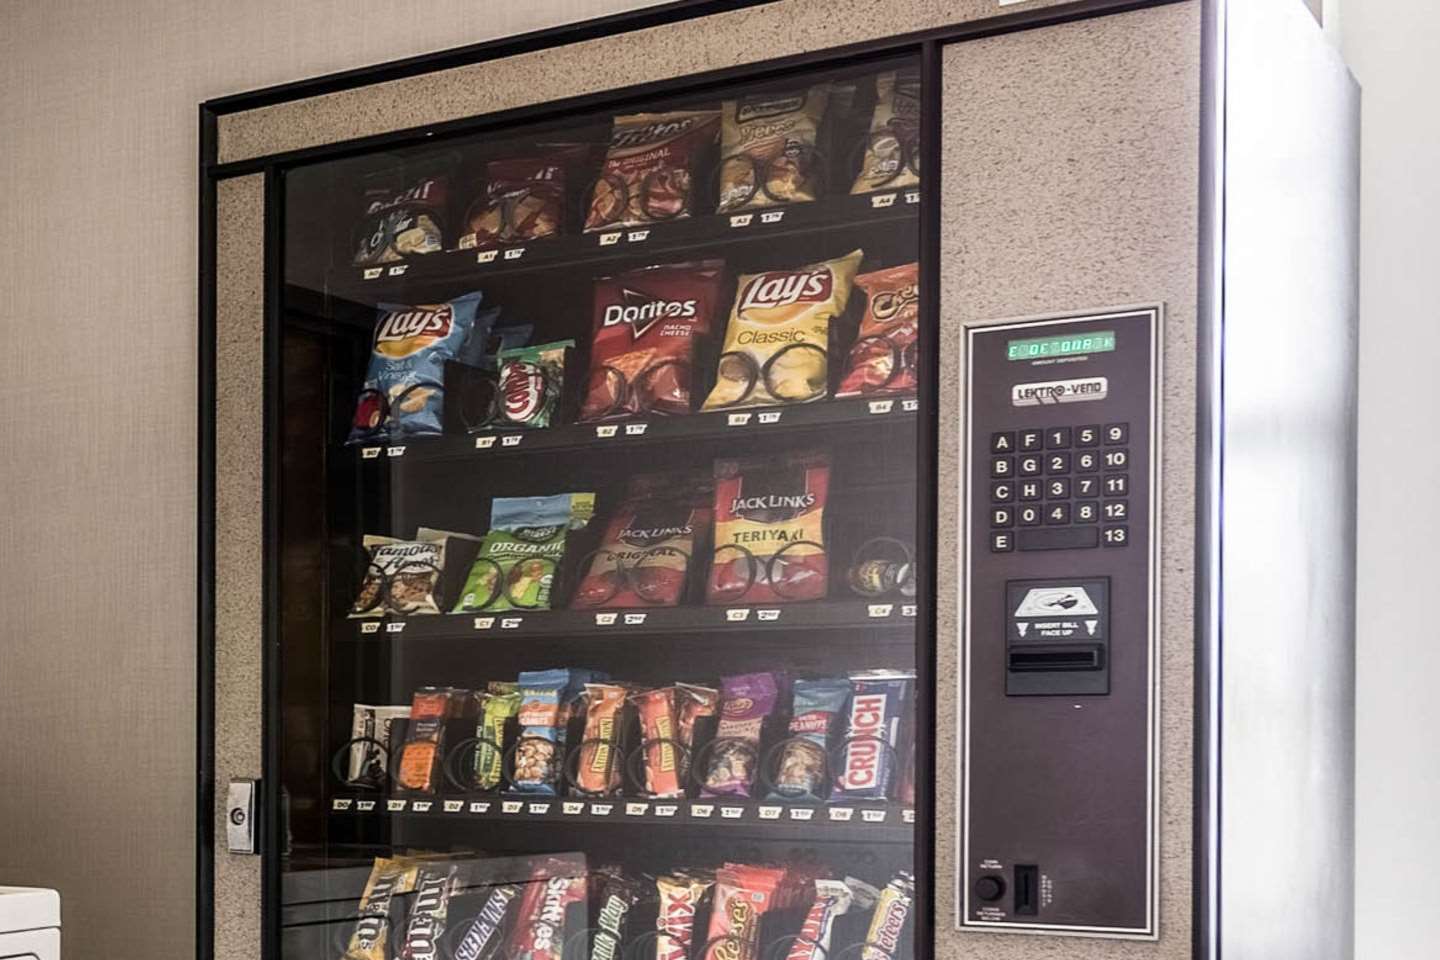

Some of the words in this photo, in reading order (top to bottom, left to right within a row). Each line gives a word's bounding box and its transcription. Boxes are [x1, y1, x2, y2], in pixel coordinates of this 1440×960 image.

[741, 270, 829, 311] Lay's
[604, 301, 696, 326] Doritos
[377, 309, 448, 341] Lay's
[737, 328, 806, 345] Classic
[1017, 383, 1102, 402] LEKTRO-VEND
[1025, 434, 1036, 447] F
[1053, 432, 1061, 445] 1
[1081, 429, 1093, 442] 5
[1110, 427, 1122, 441] 9
[996, 436, 1008, 449] A
[1023, 459, 1036, 472] G
[1052, 456, 1063, 470] 2
[1080, 454, 1093, 468] 6
[1106, 452, 1126, 466] 10
[996, 460, 1008, 473] B
[1024, 484, 1036, 497] H
[1051, 482, 1063, 495] 3
[1081, 480, 1092, 493] 7
[1107, 478, 1124, 491] 11
[996, 485, 1009, 499] C
[729, 497, 768, 513] JACK
[1105, 503, 1125, 517] 12
[996, 511, 1008, 524] D
[1051, 507, 1063, 520] 4
[1080, 505, 1092, 519] 8
[618, 527, 647, 539] JACK
[732, 528, 804, 543] TERIYAKI
[1105, 529, 1125, 542] 13
[996, 535, 1008, 548] E
[848, 697, 883, 786] CRUNCH
